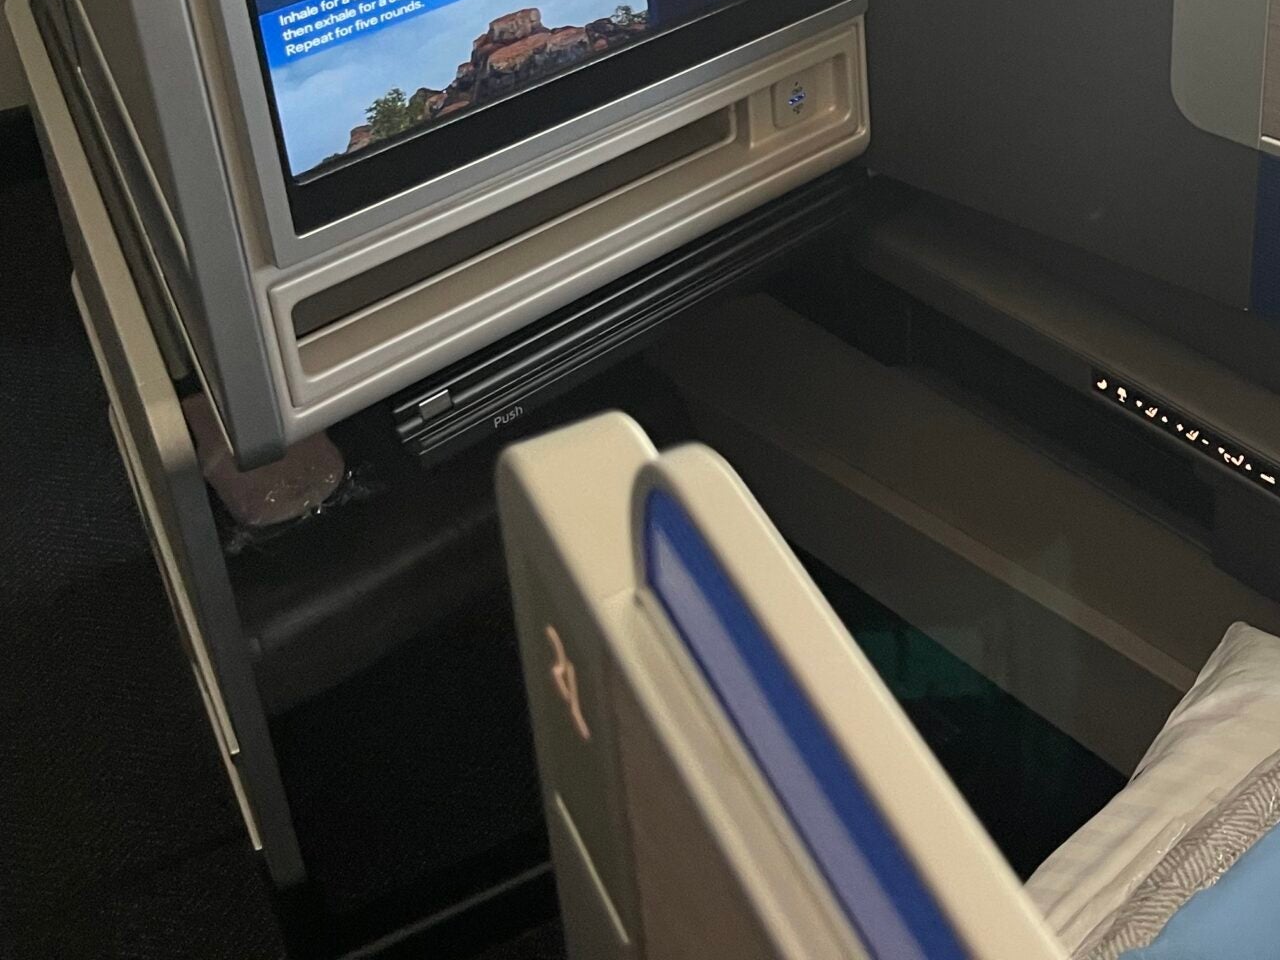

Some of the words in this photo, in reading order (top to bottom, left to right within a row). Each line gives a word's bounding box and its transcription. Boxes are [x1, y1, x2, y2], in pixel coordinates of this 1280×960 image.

[279, 5, 318, 27] Inhale
[282, 23, 313, 42] then
[315, 8, 357, 30] exhale
[359, 0, 376, 14] for
[286, 31, 334, 57] Repeat
[335, 25, 353, 39] for
[355, 17, 379, 32] five
[380, 0, 425, 23] rounds.
[494, 406, 523, 428] Push
